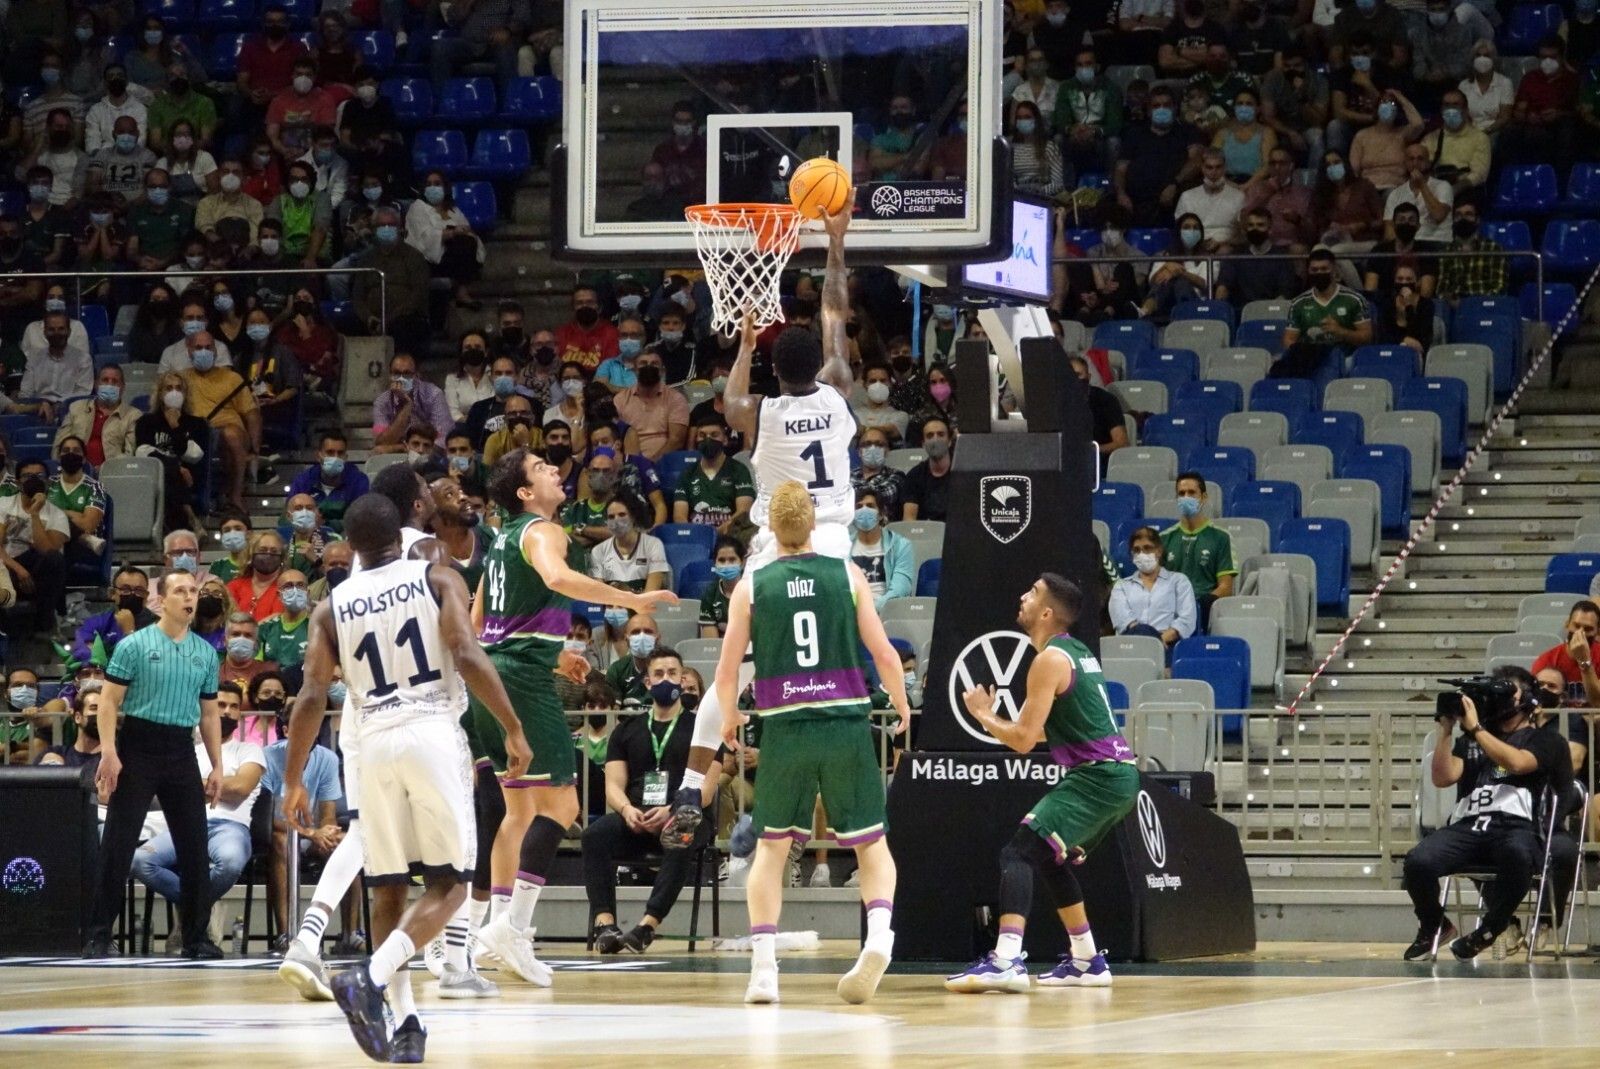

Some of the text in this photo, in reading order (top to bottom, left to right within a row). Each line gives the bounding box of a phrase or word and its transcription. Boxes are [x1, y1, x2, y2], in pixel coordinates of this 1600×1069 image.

[903, 189, 956, 197] BASKETBALL
[903, 197, 963, 205] CHAMPIONS
[785, 414, 832, 435] KELLY
[799, 440, 834, 489] 1
[991, 507, 1020, 517] Unicaja
[787, 576, 816, 598] DÍAZ
[338, 579, 425, 623] HOLSTON
[793, 611, 819, 667] 9
[353, 617, 442, 698] 11
[912, 757, 1070, 785] Málaga Wag
